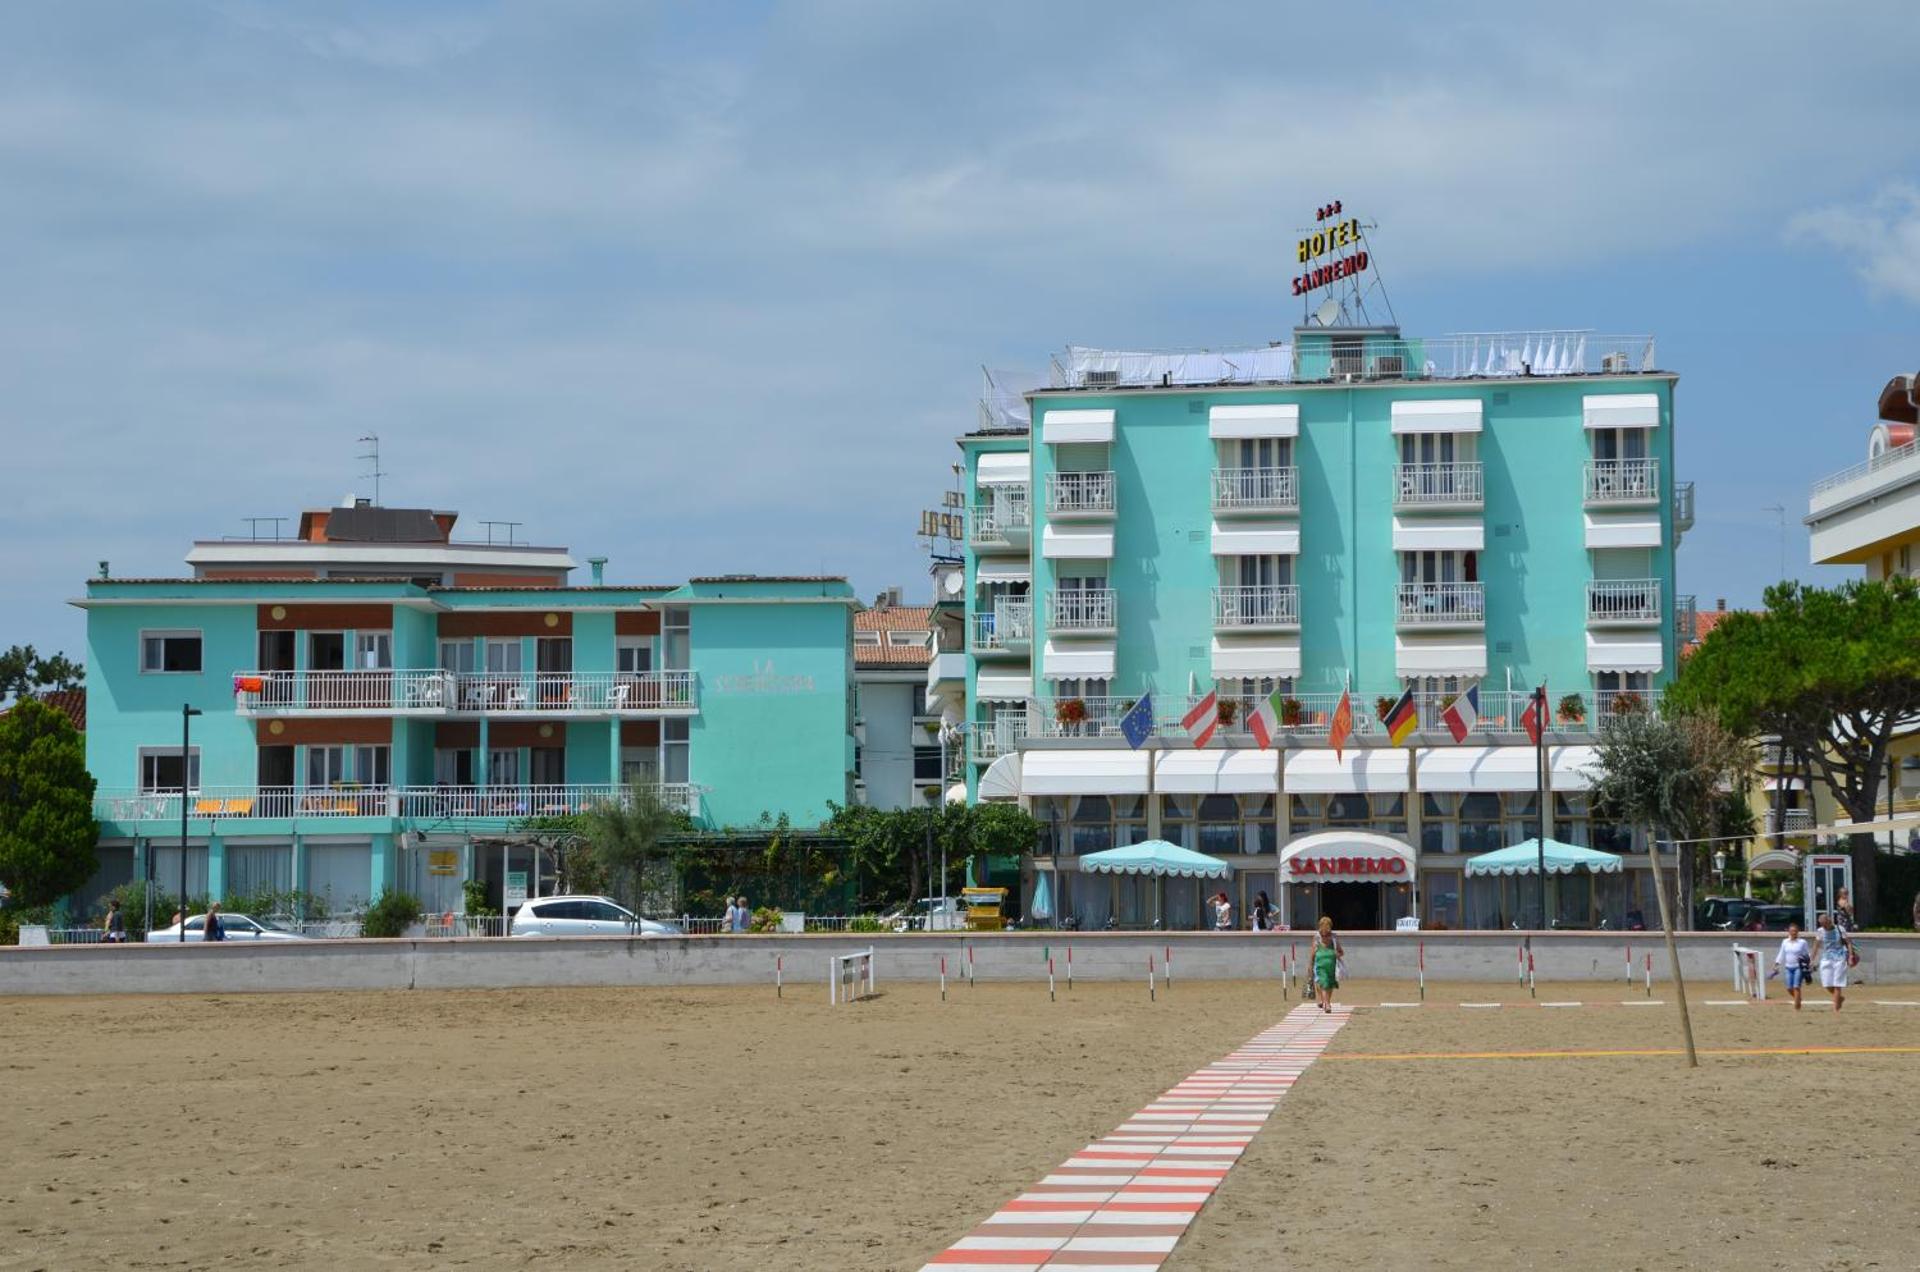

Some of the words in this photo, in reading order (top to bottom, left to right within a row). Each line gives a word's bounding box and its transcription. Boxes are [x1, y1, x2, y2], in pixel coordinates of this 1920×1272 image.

[1297, 219, 1361, 263] HOTEL
[1291, 251, 1369, 296] SANREMO
[1289, 856, 1407, 876] SANREMO
